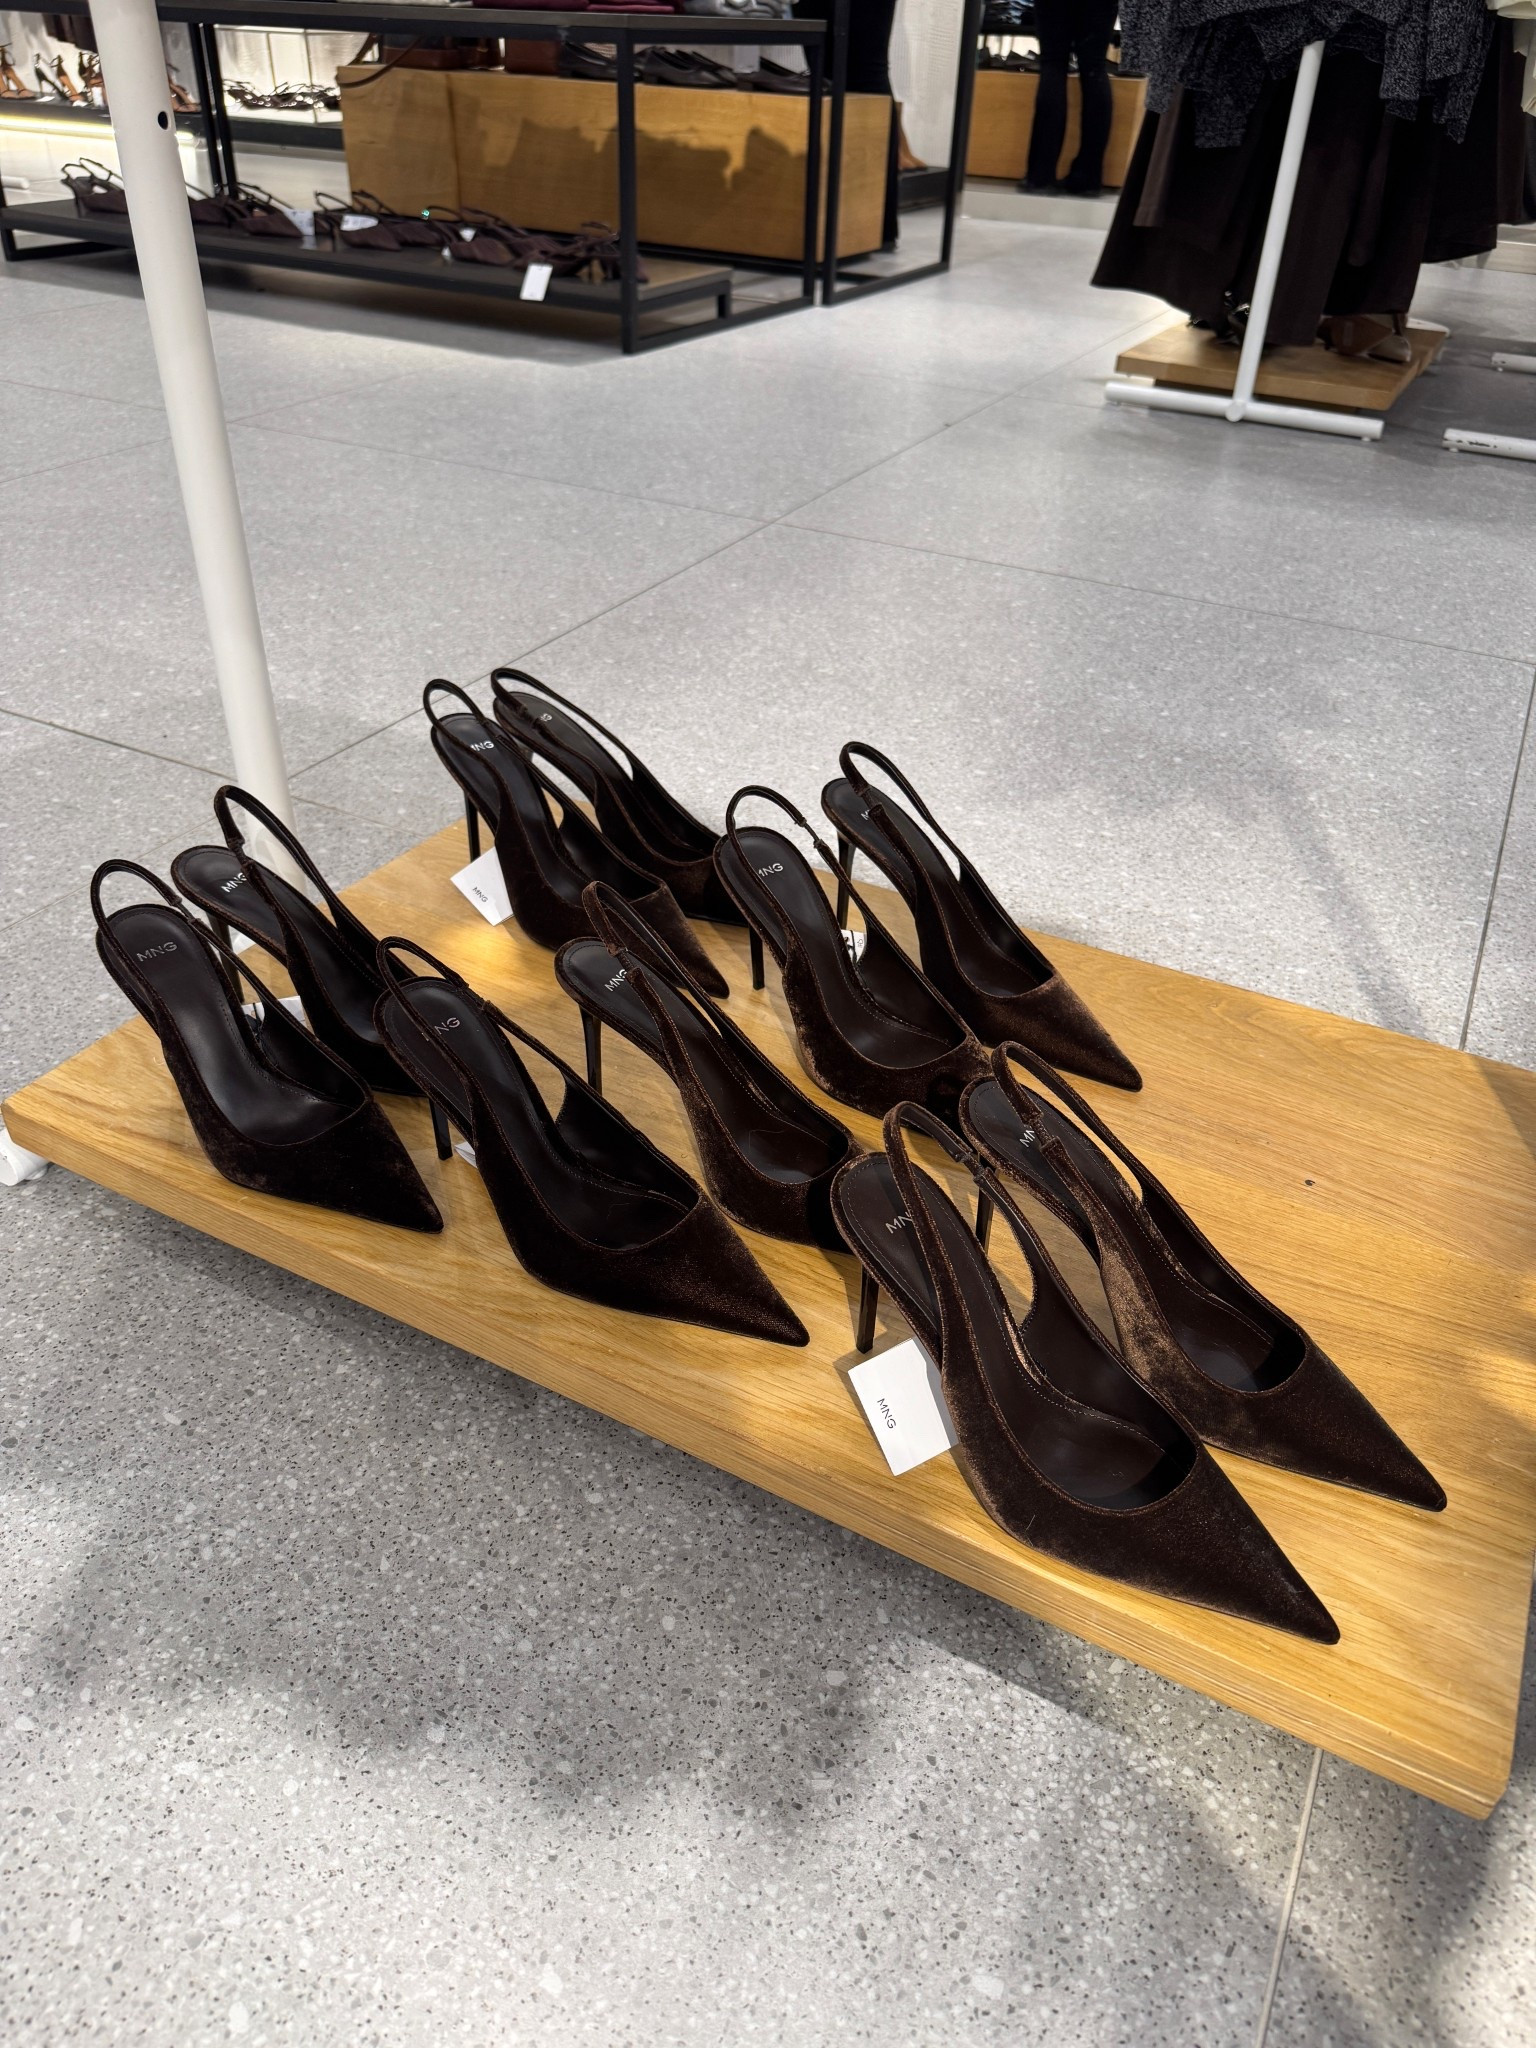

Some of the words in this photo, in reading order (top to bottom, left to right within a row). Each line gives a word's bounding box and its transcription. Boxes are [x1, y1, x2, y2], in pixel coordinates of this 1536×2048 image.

[472, 886, 488, 903] MNG
[136, 941, 178, 962] MNG
[1019, 1129, 1036, 1148] MN
[885, 1211, 912, 1234] MN
[876, 1398, 897, 1429] MNG
